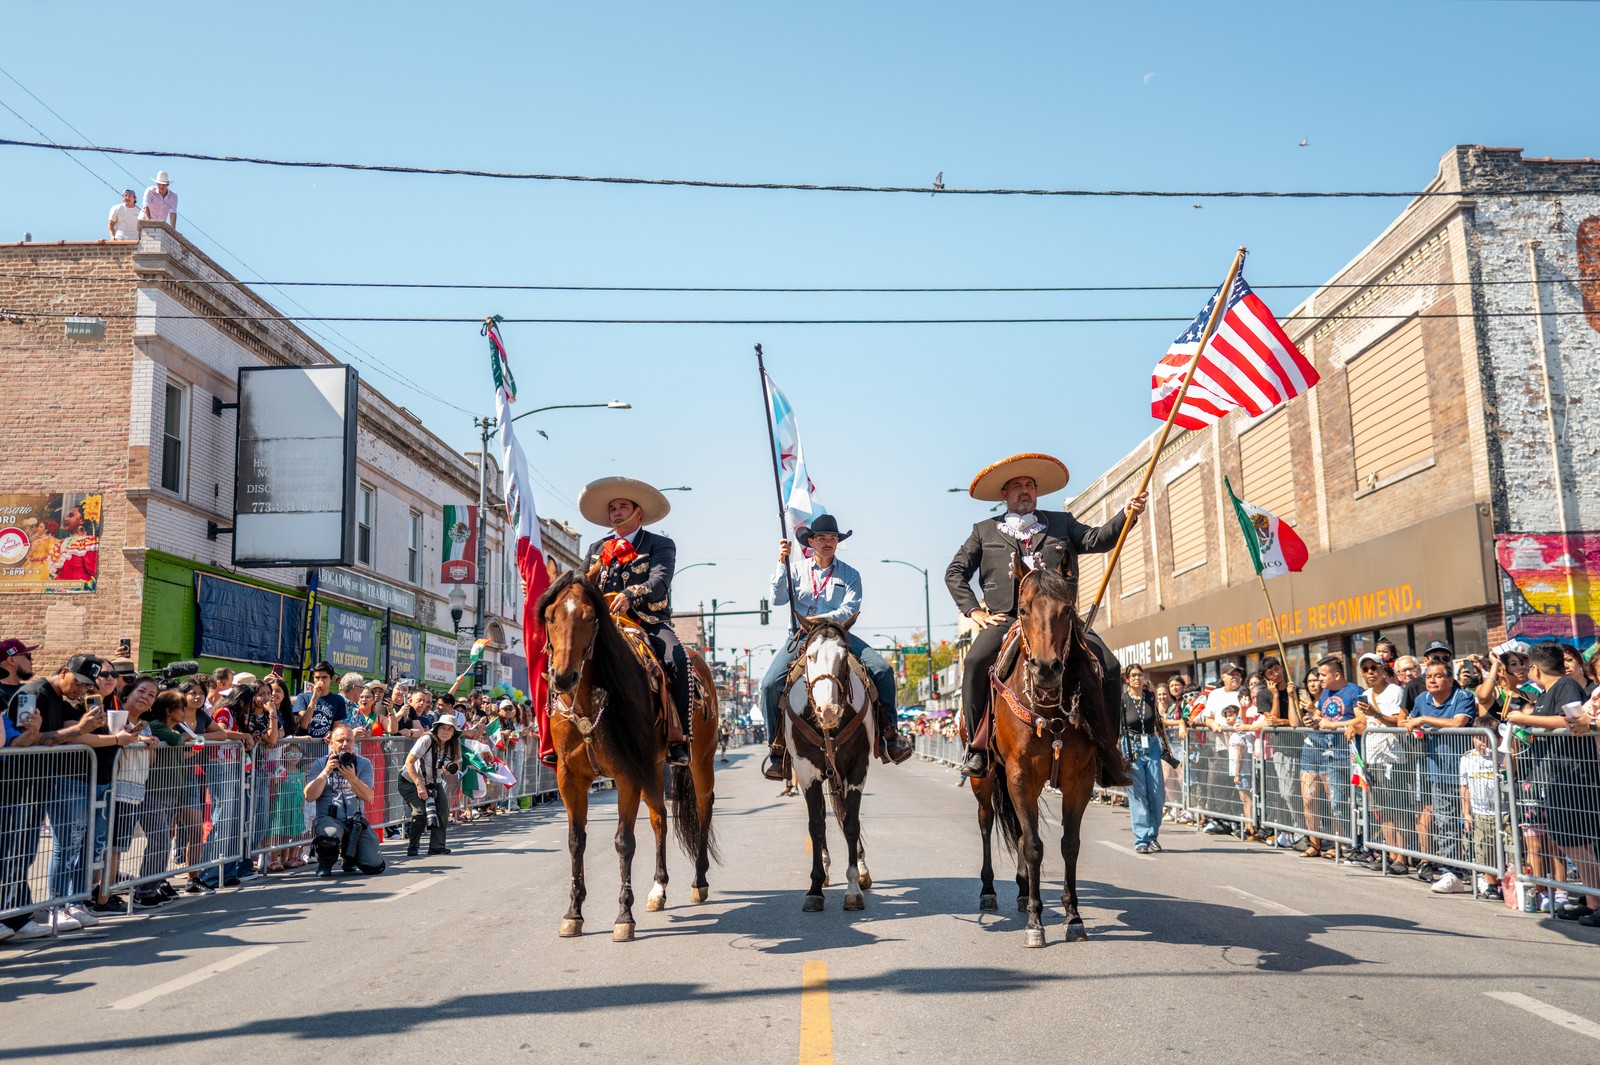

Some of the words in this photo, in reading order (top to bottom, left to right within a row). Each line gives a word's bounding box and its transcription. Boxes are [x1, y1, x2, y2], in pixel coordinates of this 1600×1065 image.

[318, 567, 351, 591] ABOGADOS
[351, 581, 359, 590] DE
[359, 583, 367, 593] LOS
[367, 584, 408, 608] TRABAJADORES
[340, 613, 367, 631] SPANGLISH
[1220, 622, 1253, 649] STORE
[1257, 609, 1302, 641] PEOPLE
[1308, 584, 1421, 631] RECOMMEND.
[342, 628, 362, 642] NATION
[391, 629, 413, 651] TAXES
[333, 651, 343, 665] TAX
[344, 653, 369, 669] SERVICES
[1154, 636, 1172, 662] CO.
